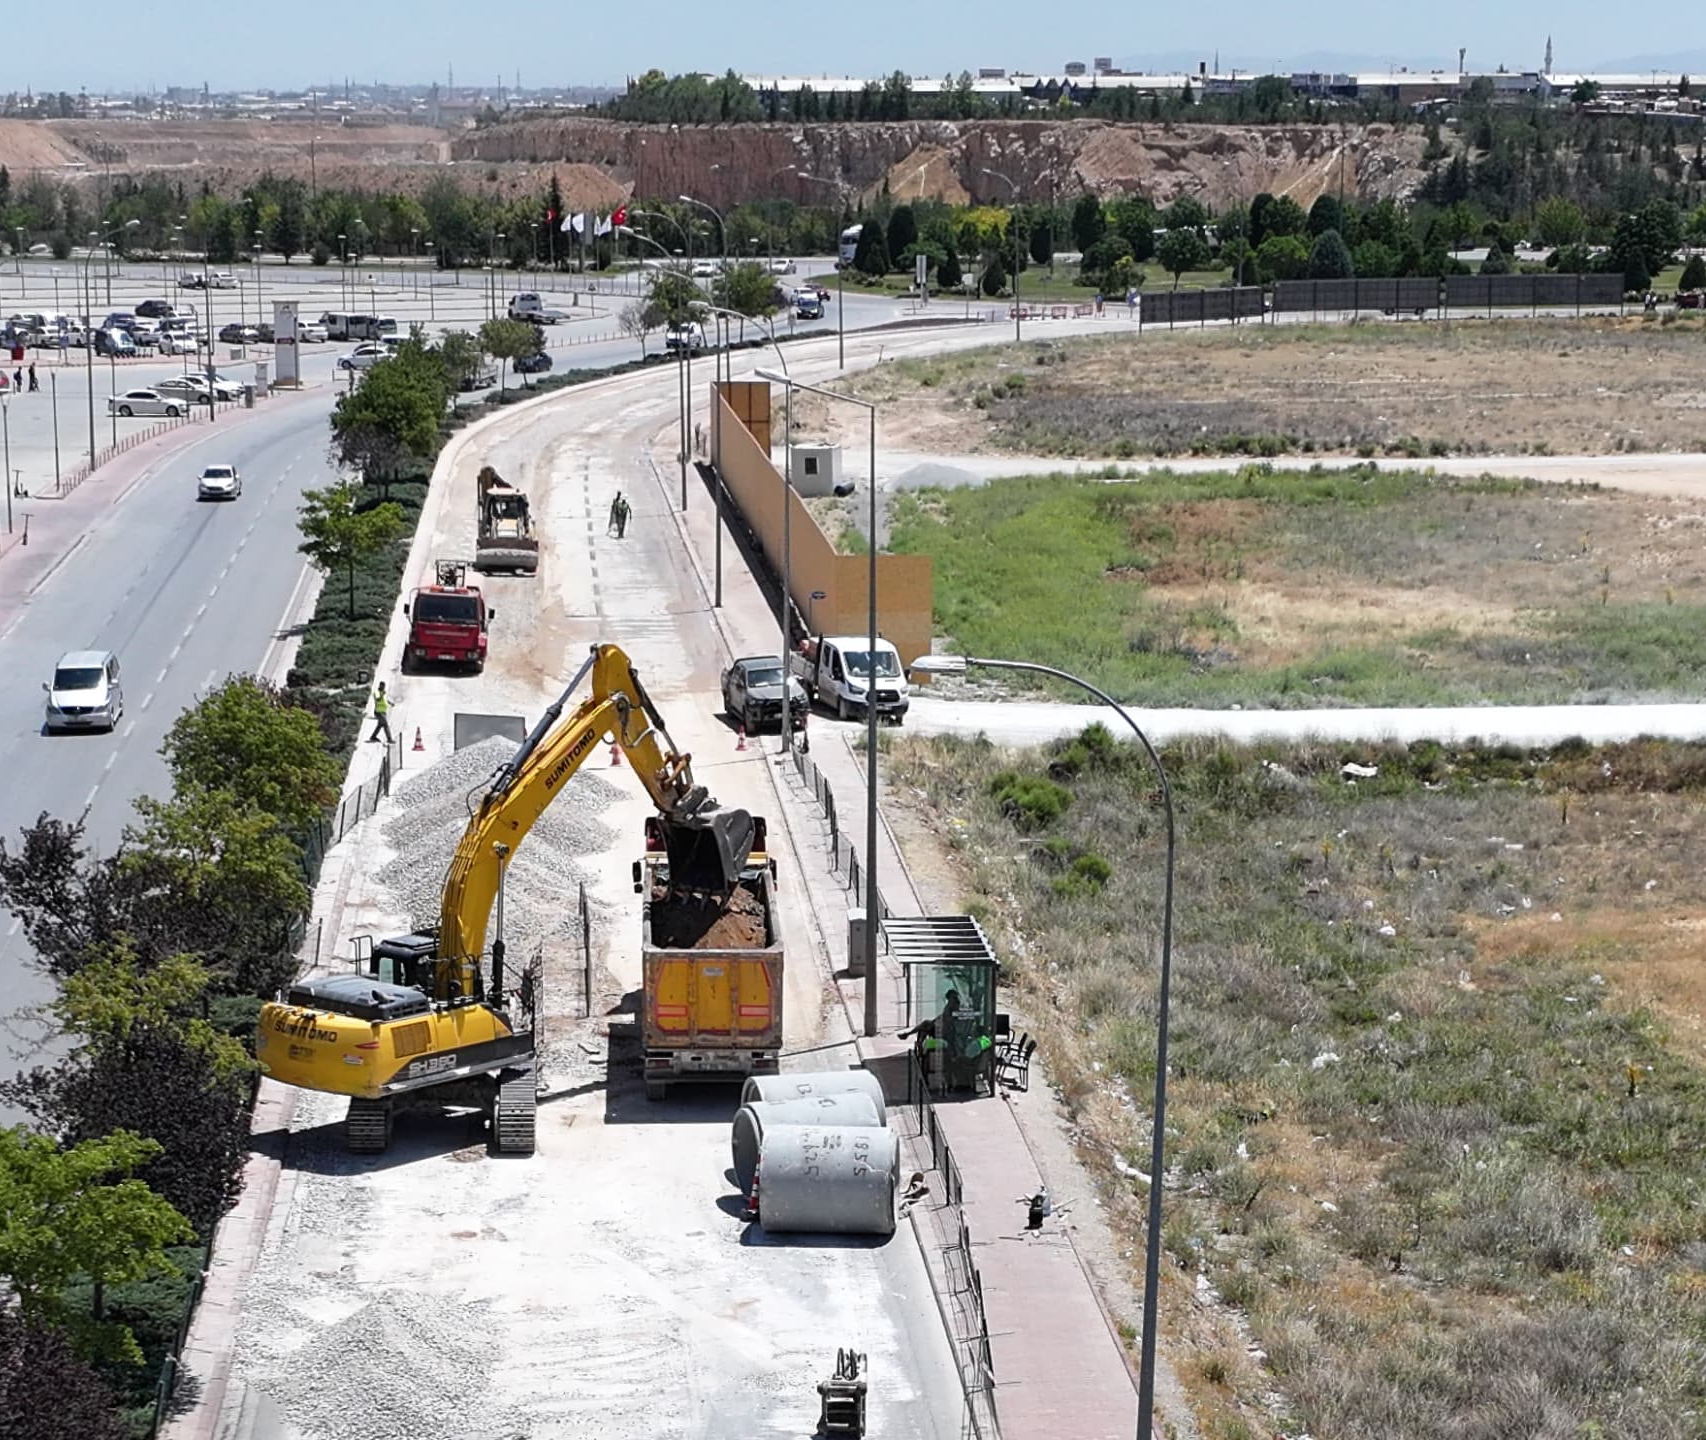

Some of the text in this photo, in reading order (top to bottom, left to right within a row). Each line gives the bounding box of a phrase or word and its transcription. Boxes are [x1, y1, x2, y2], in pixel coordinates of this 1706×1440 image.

[545, 728, 595, 790] SUMITOMO
[275, 1020, 338, 1044] SUMITOMO
[853, 1135, 870, 1177] 1855
